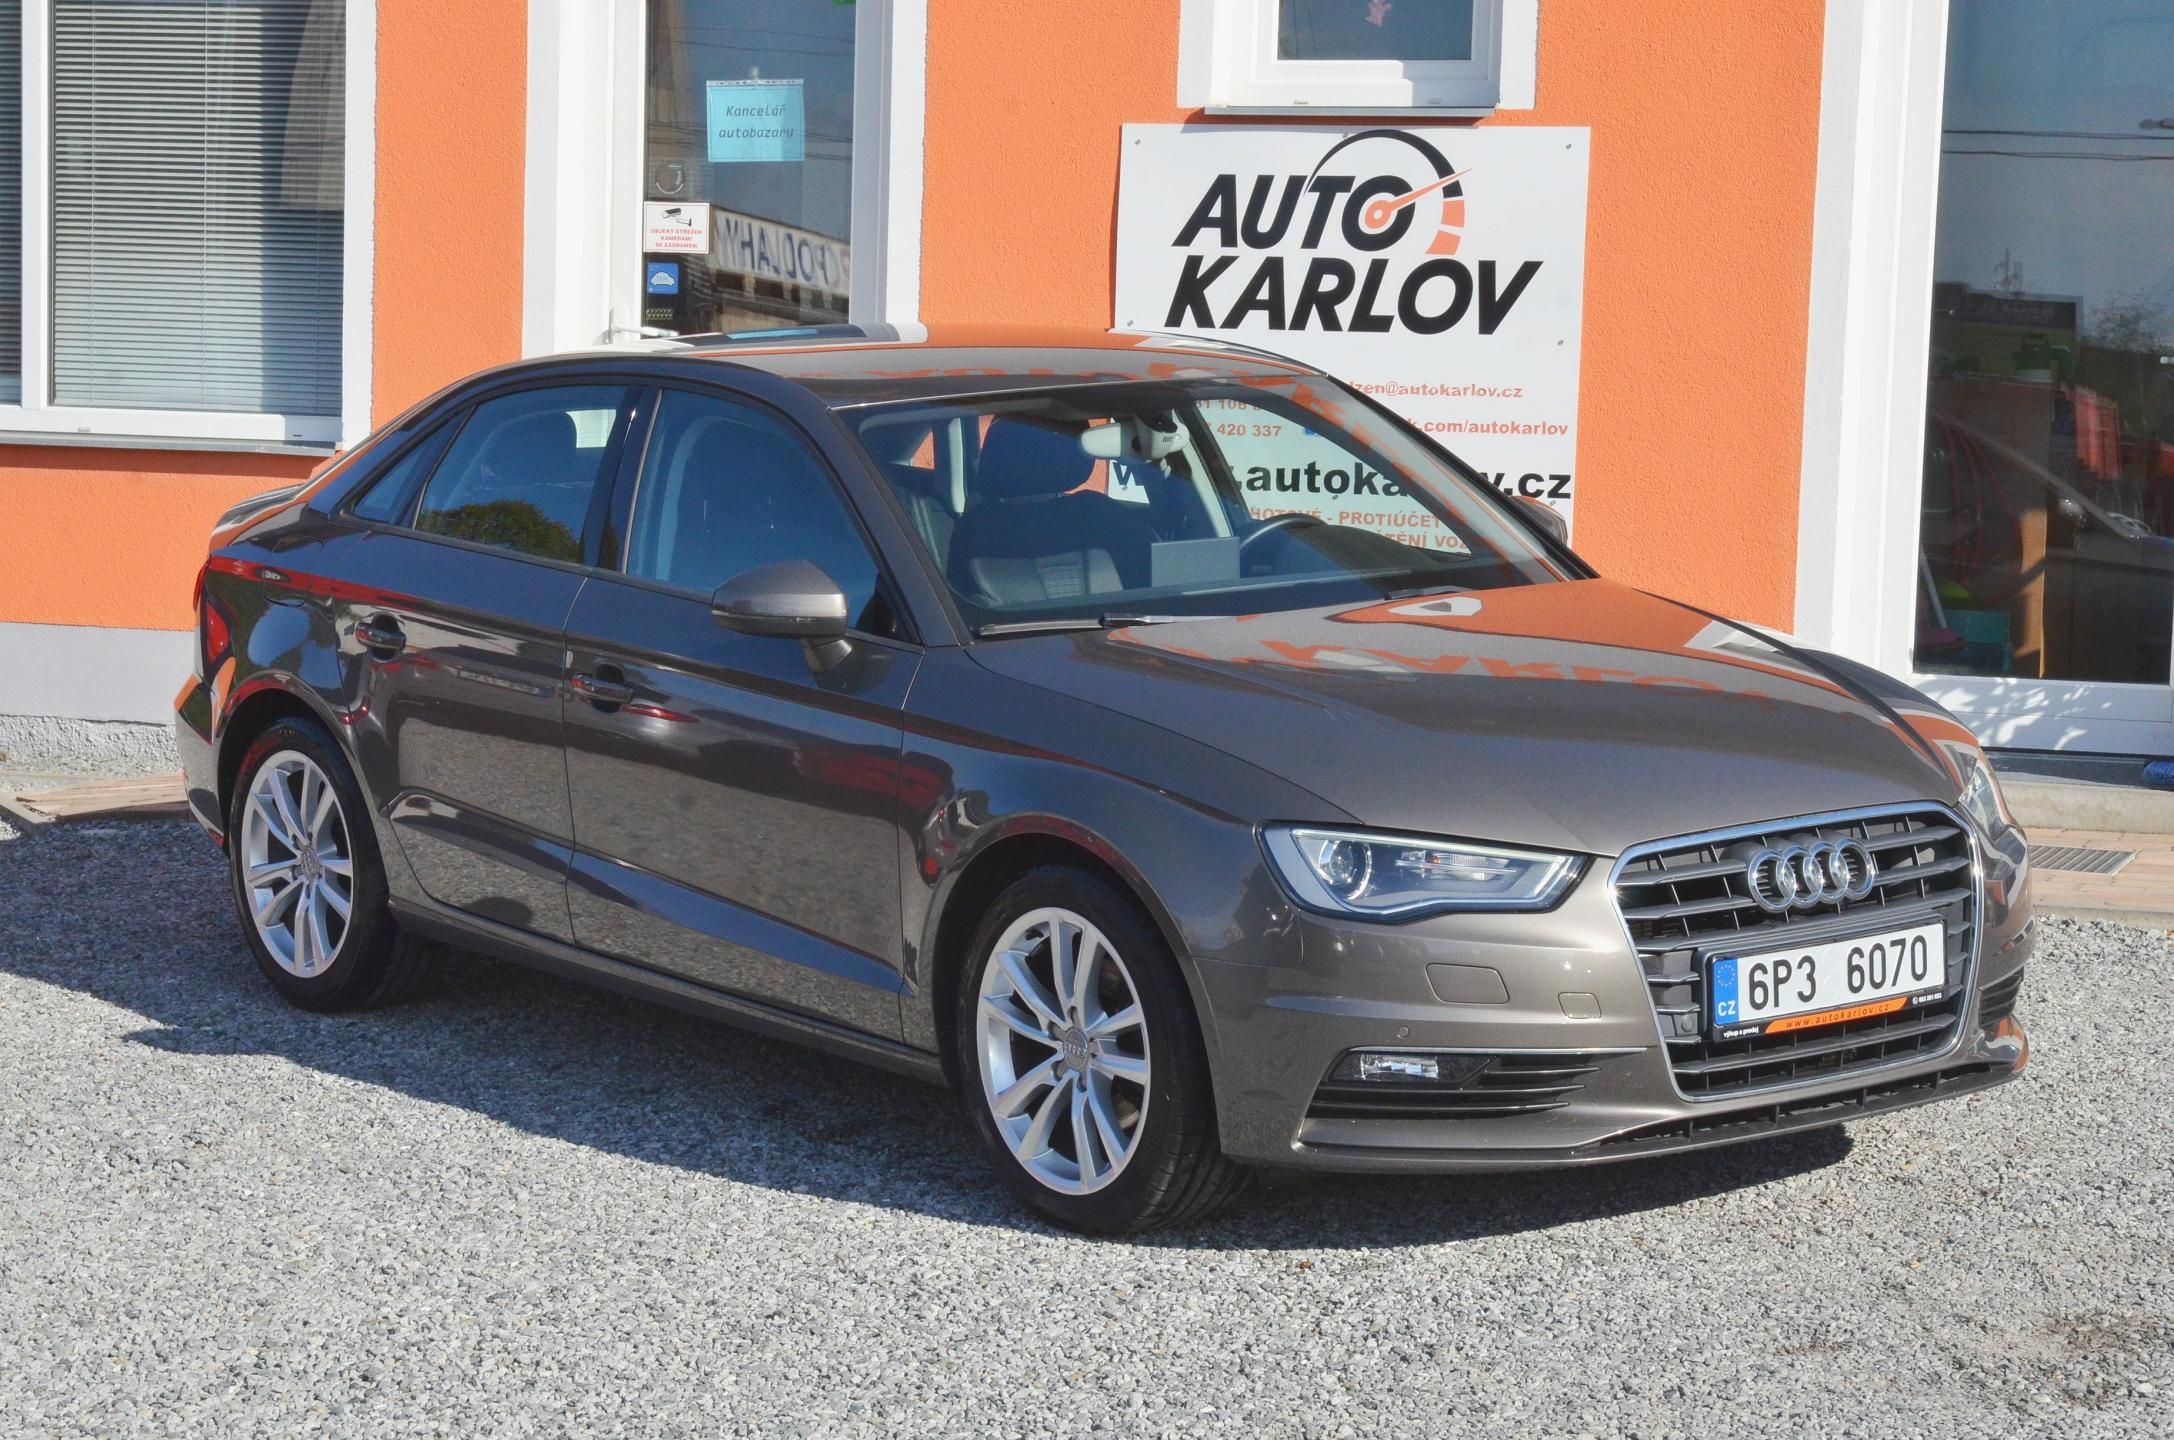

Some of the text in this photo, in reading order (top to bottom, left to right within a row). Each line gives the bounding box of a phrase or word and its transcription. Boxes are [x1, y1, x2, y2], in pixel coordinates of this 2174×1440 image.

[726, 104, 787, 117] Kancelář
[718, 127, 794, 138] autobazaru
[1171, 174, 1416, 251] AUTO
[1164, 255, 1544, 335] KARLOV
[1217, 423, 1247, 436] 420
[1252, 424, 1282, 437] 337
[1338, 510, 1441, 529] PROTIÚČET
[1748, 935, 1928, 1010] 6P3 6070
[1717, 999, 1736, 1016] CZ
[1786, 1004, 1890, 1029] www.autokarlov.cz
